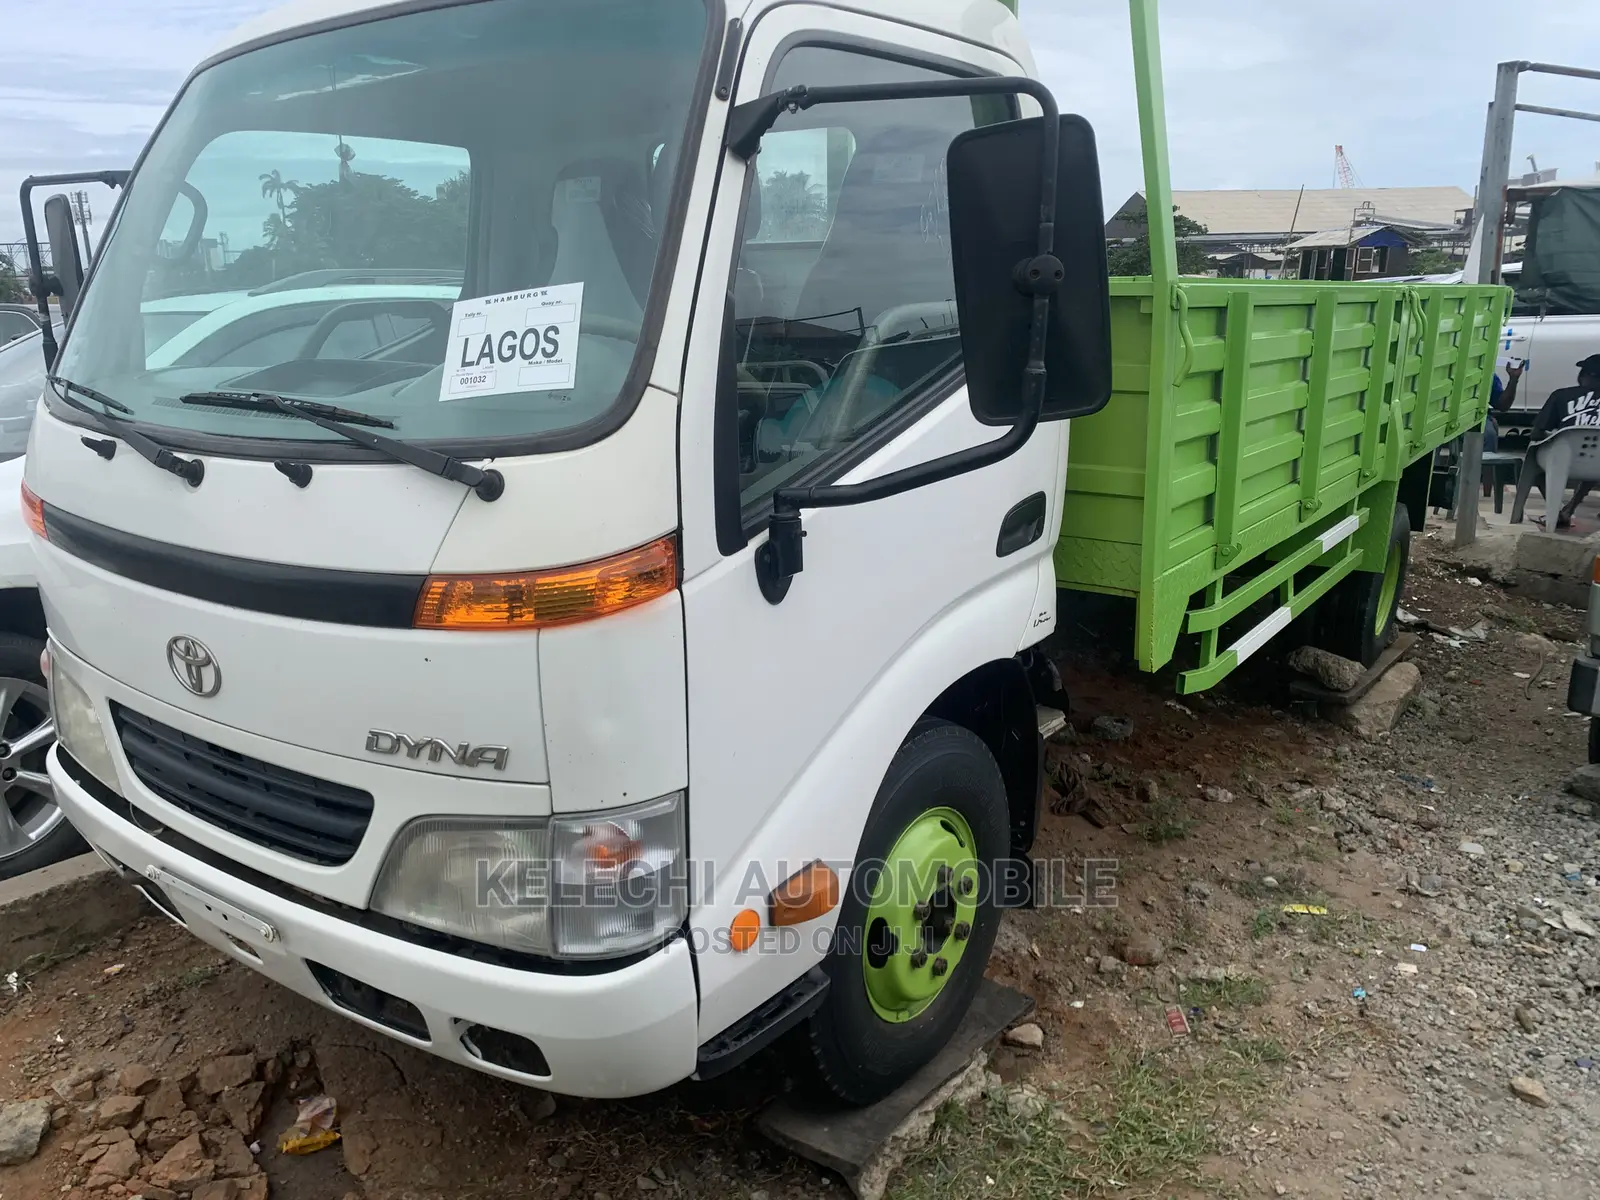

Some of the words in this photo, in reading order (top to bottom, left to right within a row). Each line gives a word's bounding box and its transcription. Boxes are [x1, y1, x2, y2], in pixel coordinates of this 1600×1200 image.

[493, 292, 539, 304] HAMBURG
[460, 325, 560, 368] LAGOS
[460, 375, 487, 385] 001032
[365, 728, 509, 771] DYNA
